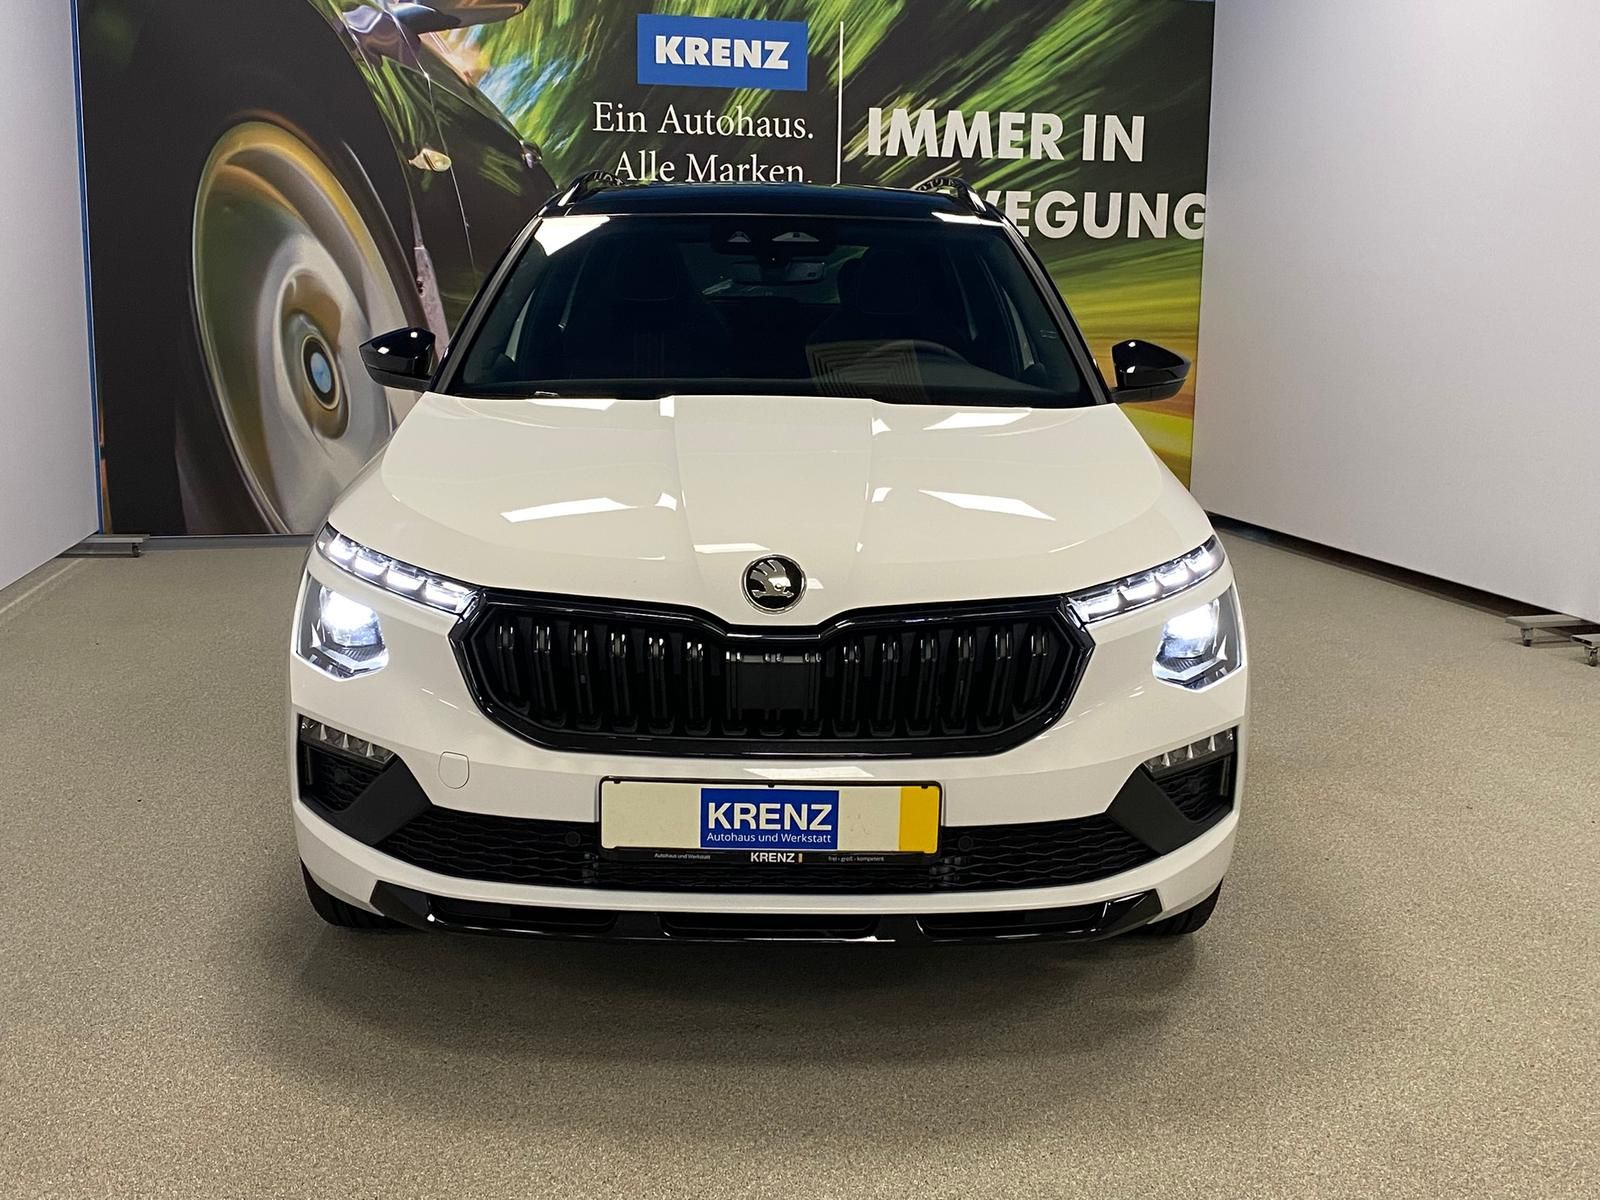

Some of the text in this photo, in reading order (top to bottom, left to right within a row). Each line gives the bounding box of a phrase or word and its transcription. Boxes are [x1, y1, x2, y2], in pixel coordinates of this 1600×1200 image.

[655, 35, 790, 70] KRENZ
[592, 101, 814, 140] Ein Autohaus.
[867, 107, 1145, 162] IMMER IN
[614, 150, 676, 182] Alle
[986, 190, 1206, 240] EGUNG
[708, 802, 833, 831] KRENZ
[706, 832, 832, 843] Autohaus und Werkstatt
[750, 852, 796, 863] KRENZ
